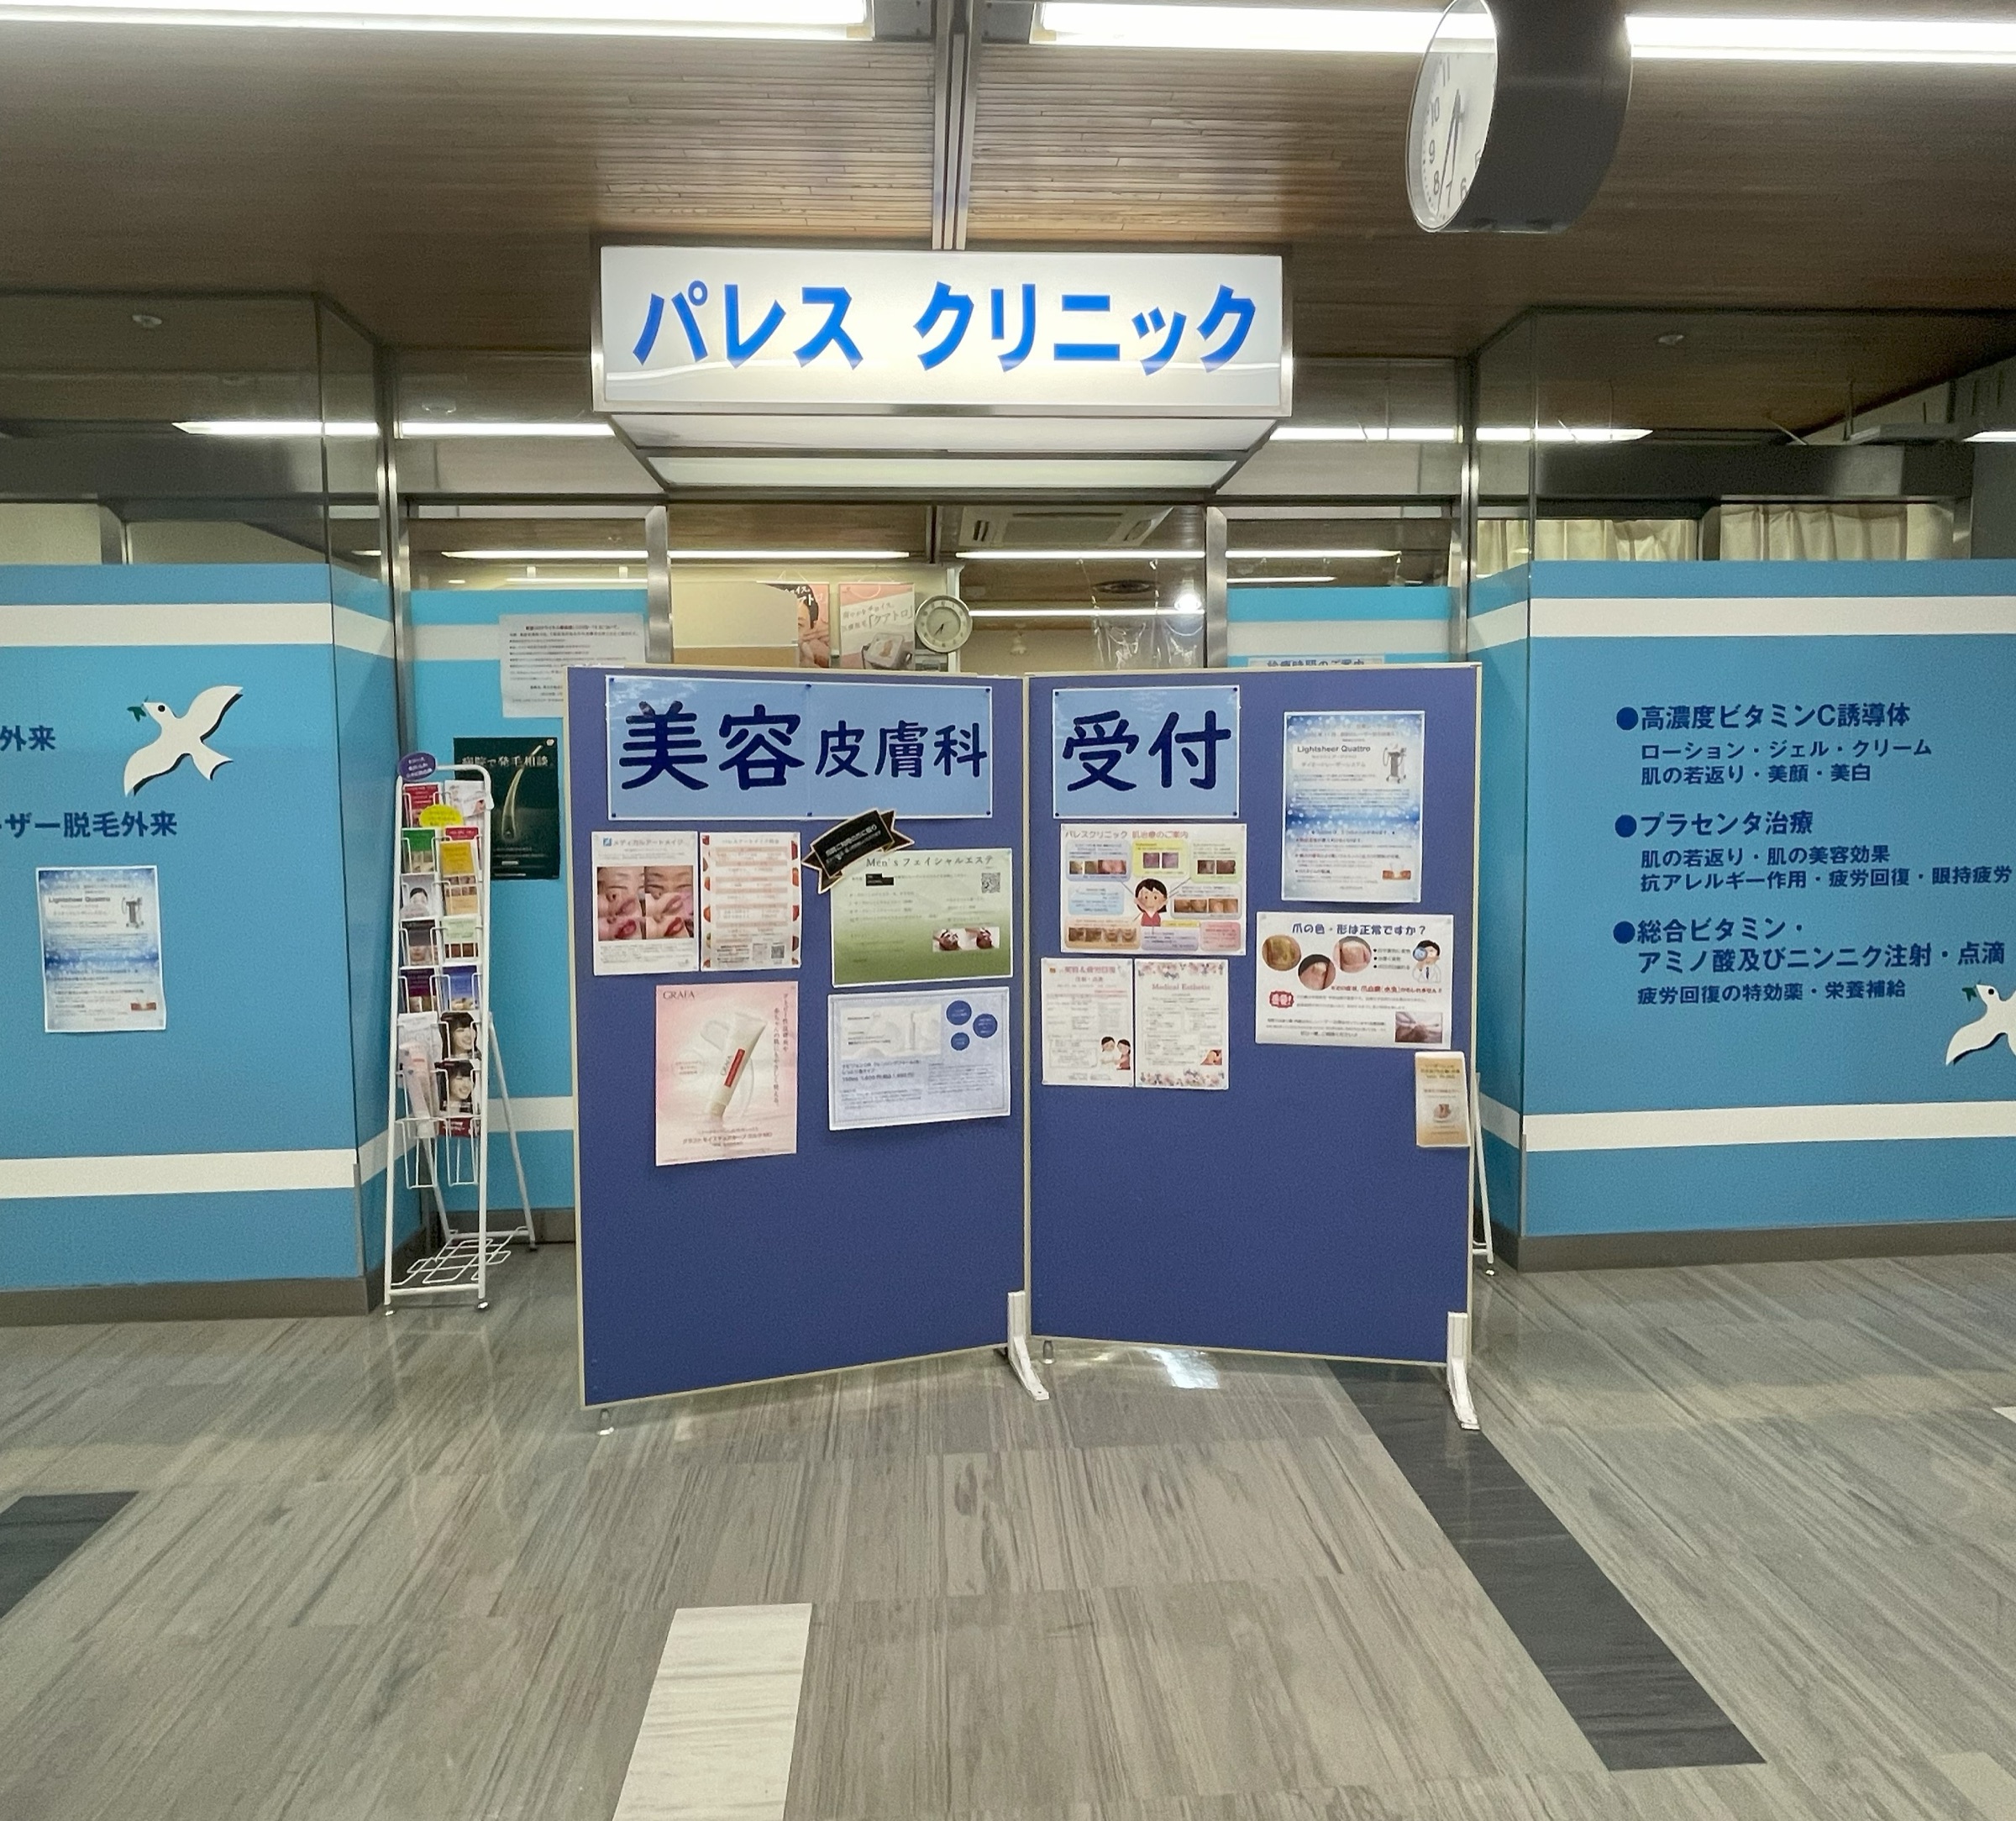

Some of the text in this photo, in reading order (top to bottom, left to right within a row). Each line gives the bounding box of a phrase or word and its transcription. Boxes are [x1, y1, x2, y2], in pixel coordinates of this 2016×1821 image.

[1429, 139, 1435, 164] 9
[1433, 171, 1440, 195] 8
[1446, 179, 1452, 207] 7
[633, 280, 1257, 375] パレス クリニック
[1641, 702, 1911, 731] 高濃度ビタミンC誘導体
[0, 725, 56, 752] 外来
[618, 701, 988, 790] 美容皮膚科
[1062, 710, 1232, 792] 受付
[1641, 738, 1932, 761] ローション・ジェル・クリーム
[1641, 764, 1872, 785] 肌の若返り・美顔・美白
[0, 810, 177, 838] ザー脱毛外来
[1641, 811, 1814, 837] プラセンタ治療
[1641, 845, 1890, 869] 肌の若返り・肌の美容効果
[1638, 942, 2005, 973] アミノ酸及びニンニク注射・点滴
[1637, 979, 1906, 1005] 疲労回復の特効薬・栄養補給
